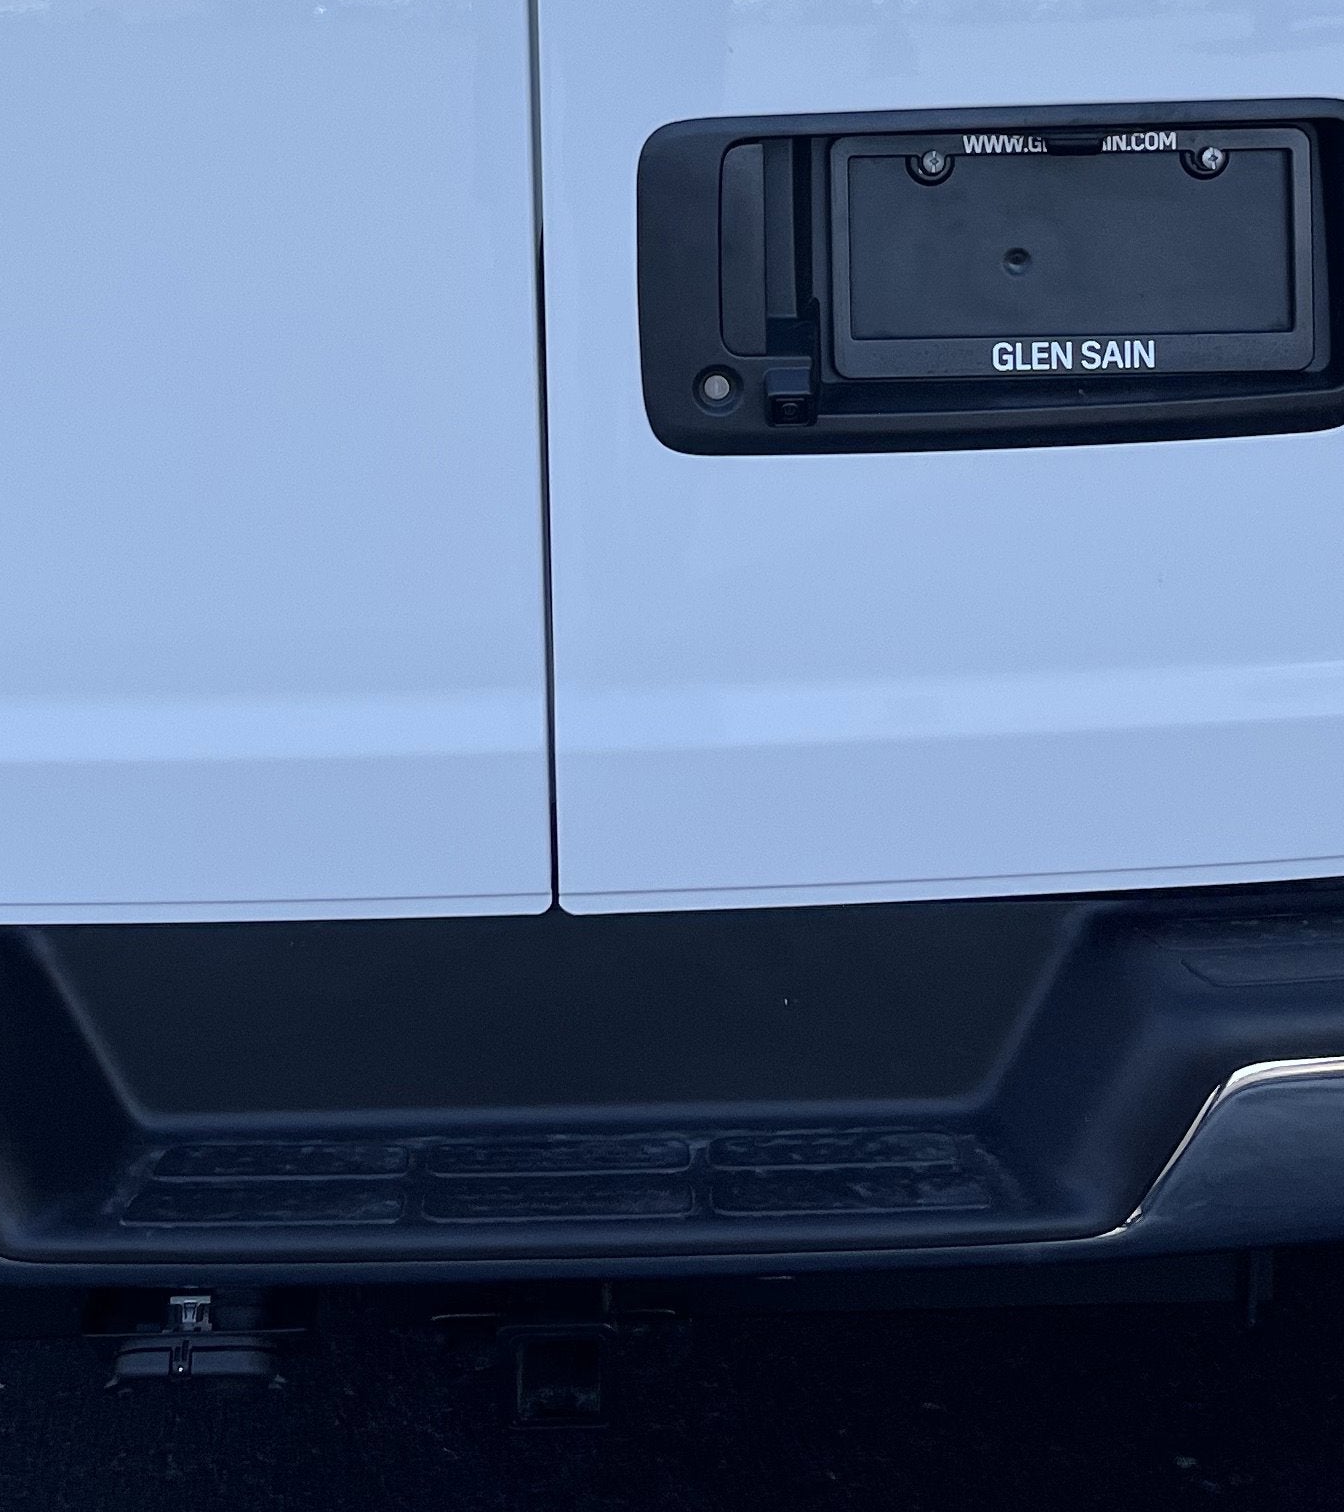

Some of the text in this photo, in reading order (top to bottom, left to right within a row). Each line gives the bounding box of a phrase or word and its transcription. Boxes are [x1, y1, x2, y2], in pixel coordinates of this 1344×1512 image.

[962, 131, 1177, 154] WWW.GIN.COM
[992, 340, 1155, 371] GLEN SAIN
